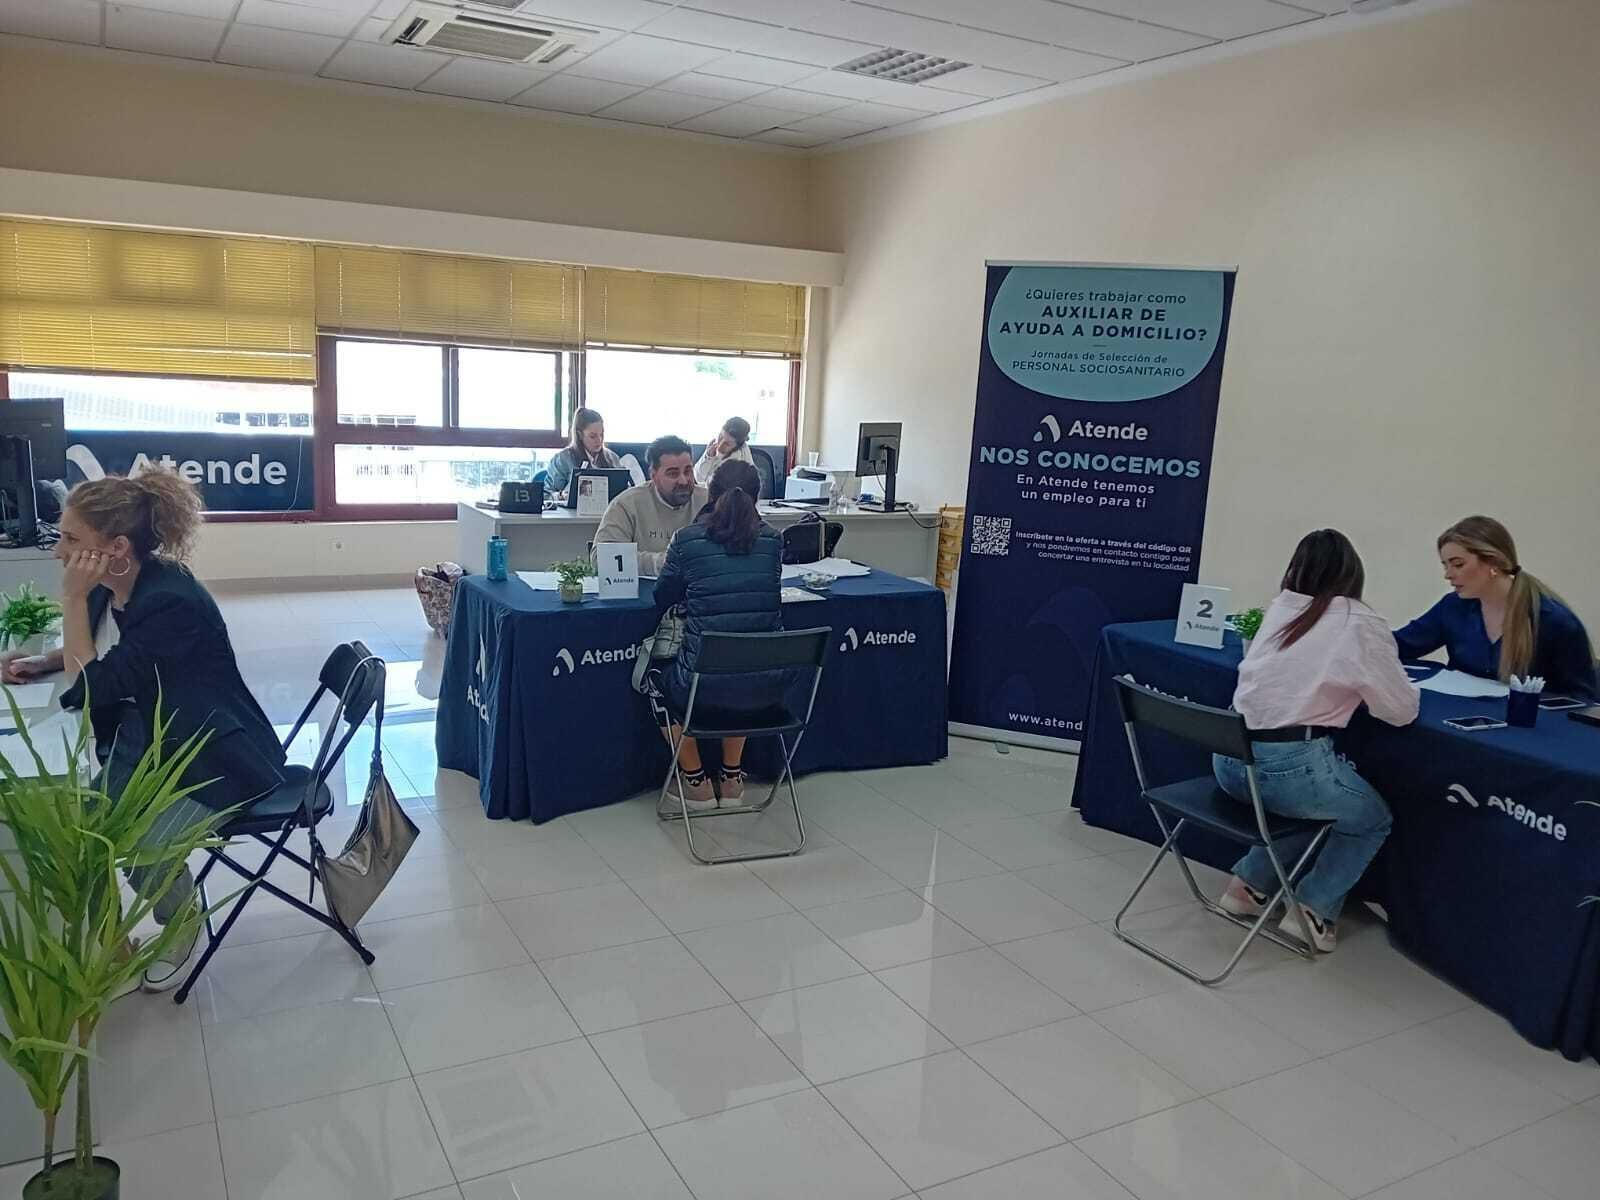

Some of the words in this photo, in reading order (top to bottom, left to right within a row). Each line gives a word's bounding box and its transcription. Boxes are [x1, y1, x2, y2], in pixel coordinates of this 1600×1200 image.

[1025, 289, 1084, 302] ¿Quieres
[1089, 291, 1145, 304] trabajar
[1147, 294, 1187, 304] como
[1042, 305, 1133, 320] AUXILIAR
[1140, 309, 1167, 322] DE
[1000, 322, 1065, 336] AYUDA
[1072, 325, 1085, 337] A
[1092, 325, 1208, 341] DOMICILIO?
[1031, 350, 1079, 360] Jornadas
[1082, 352, 1095, 361] de
[1099, 352, 1151, 363] Selección
[1154, 354, 1168, 364] de
[1012, 361, 1076, 373] PERSONAL
[1079, 364, 1186, 377] SOCIOSANITARIO
[1068, 420, 1149, 441] Atende
[979, 446, 1030, 466] NOS
[1037, 450, 1201, 478] CONOCEMOS
[1016, 474, 1033, 485] En
[1038, 475, 1089, 489] Atende
[1093, 479, 1156, 494] tenemos
[1021, 490, 1038, 500] un
[1042, 491, 1094, 505] empleo
[1098, 495, 1131, 508] para
[1135, 497, 1147, 509] ti
[1032, 542, 1046, 550] nos
[1047, 542, 1091, 554] pondremos
[1092, 546, 1102, 554] en
[1103, 547, 1139, 558] contacto
[1140, 552, 1171, 562] contigo
[1066, 535, 1074, 543] la
[1075, 536, 1099, 546] oferta
[1107, 538, 1132, 549] través
[1133, 541, 1147, 550] del
[1148, 542, 1177, 554] código
[1178, 545, 1192, 554] QR
[613, 554, 624, 573] 1
[1038, 551, 1074, 561] concertar
[1091, 556, 1130, 567] entrevista
[1142, 560, 1152, 568] tu
[1153, 561, 1190, 572] localidad
[1196, 599, 1214, 619] 2
[863, 629, 917, 645] Atende
[1487, 794, 1568, 841] Atende
